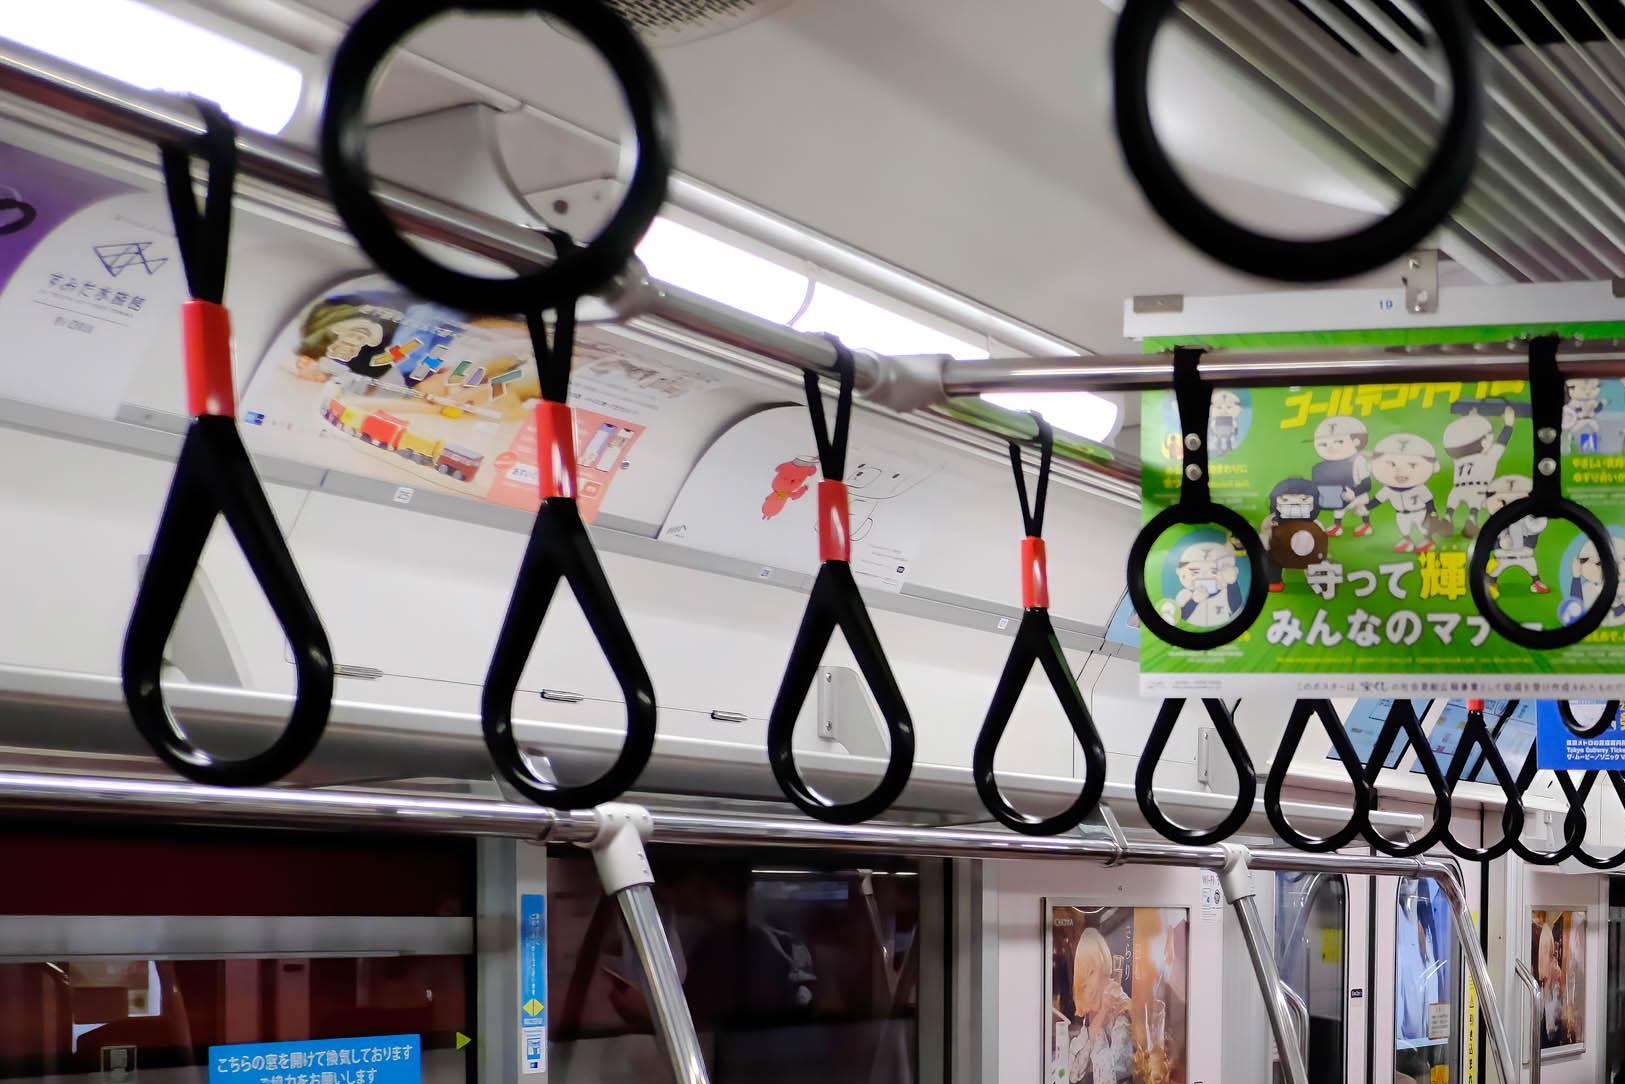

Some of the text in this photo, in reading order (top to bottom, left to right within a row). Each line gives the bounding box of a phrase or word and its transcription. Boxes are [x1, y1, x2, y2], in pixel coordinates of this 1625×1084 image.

[1457, 462, 1474, 477] 17
[217, 1044, 414, 1074] こちらの窓を開けて換気しております
